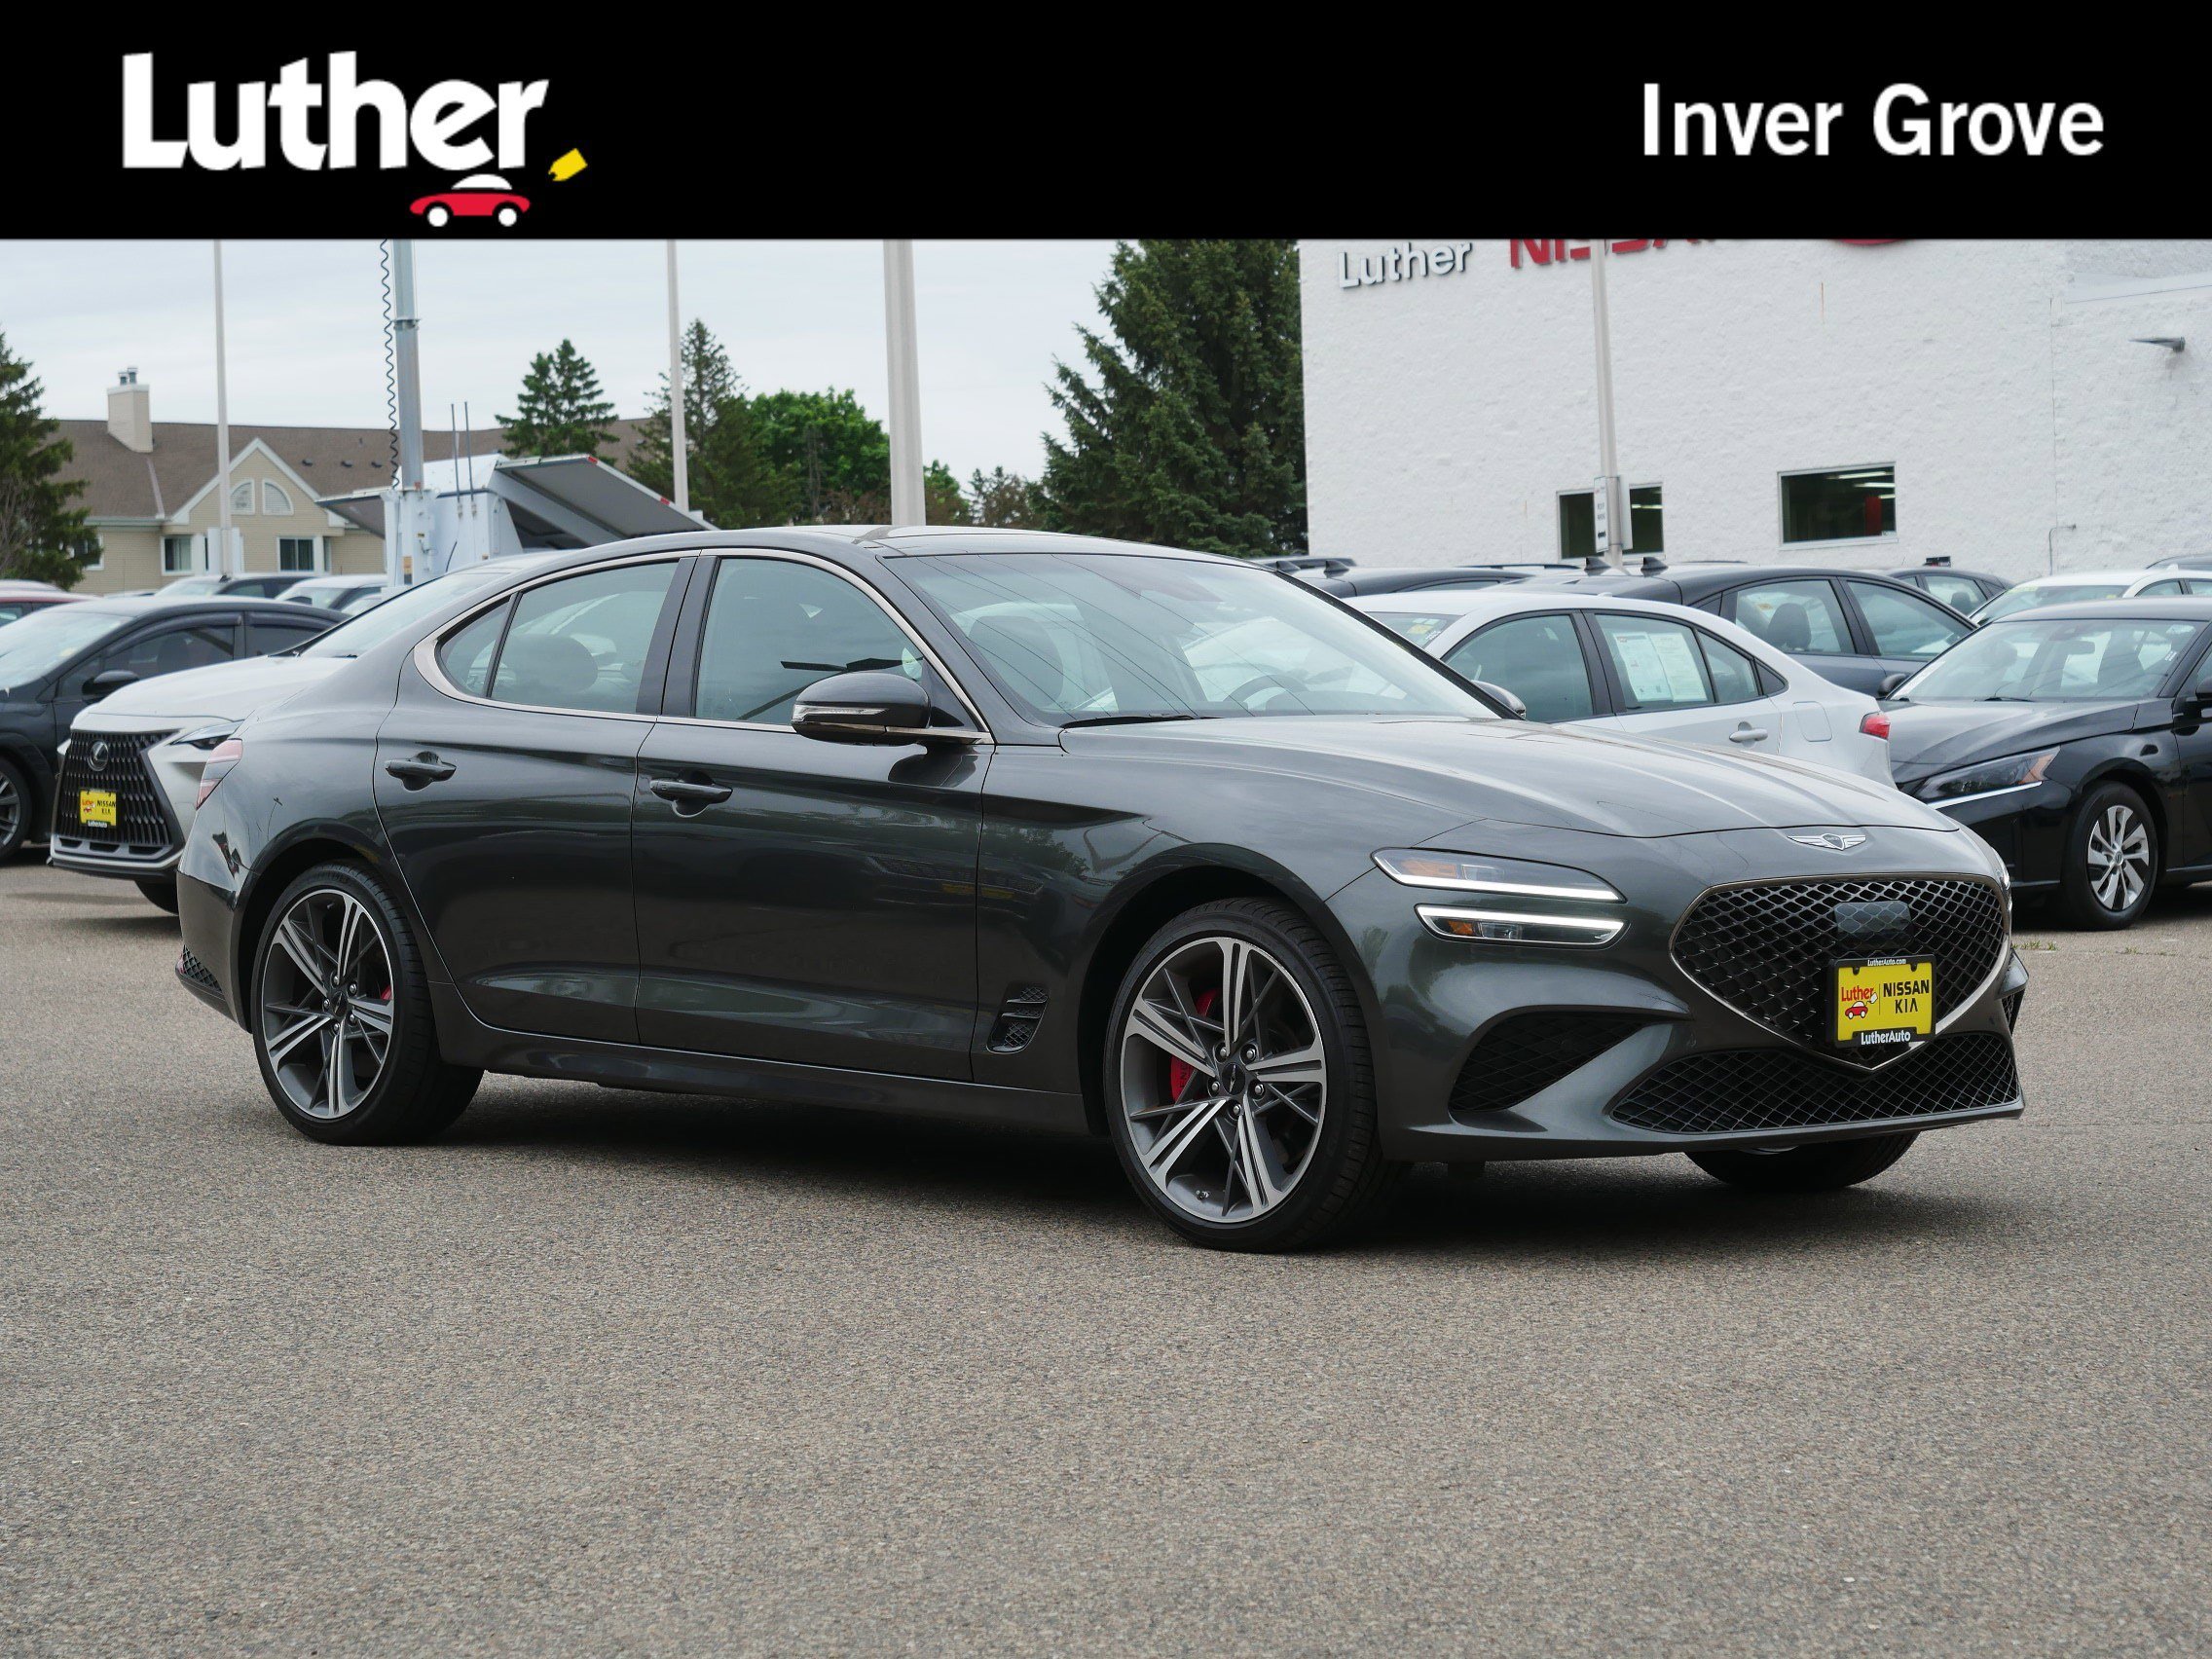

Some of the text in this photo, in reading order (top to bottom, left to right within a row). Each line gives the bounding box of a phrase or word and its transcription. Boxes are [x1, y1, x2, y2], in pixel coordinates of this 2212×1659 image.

[1338, 241, 1473, 289] Luther
[1866, 958, 1907, 967] LutherAuto.com
[1841, 984, 1875, 1002] Luther
[1883, 978, 1930, 998] NISSAN
[1895, 997, 1919, 1014] KIA
[1861, 1029, 1911, 1046] LutherAuto
